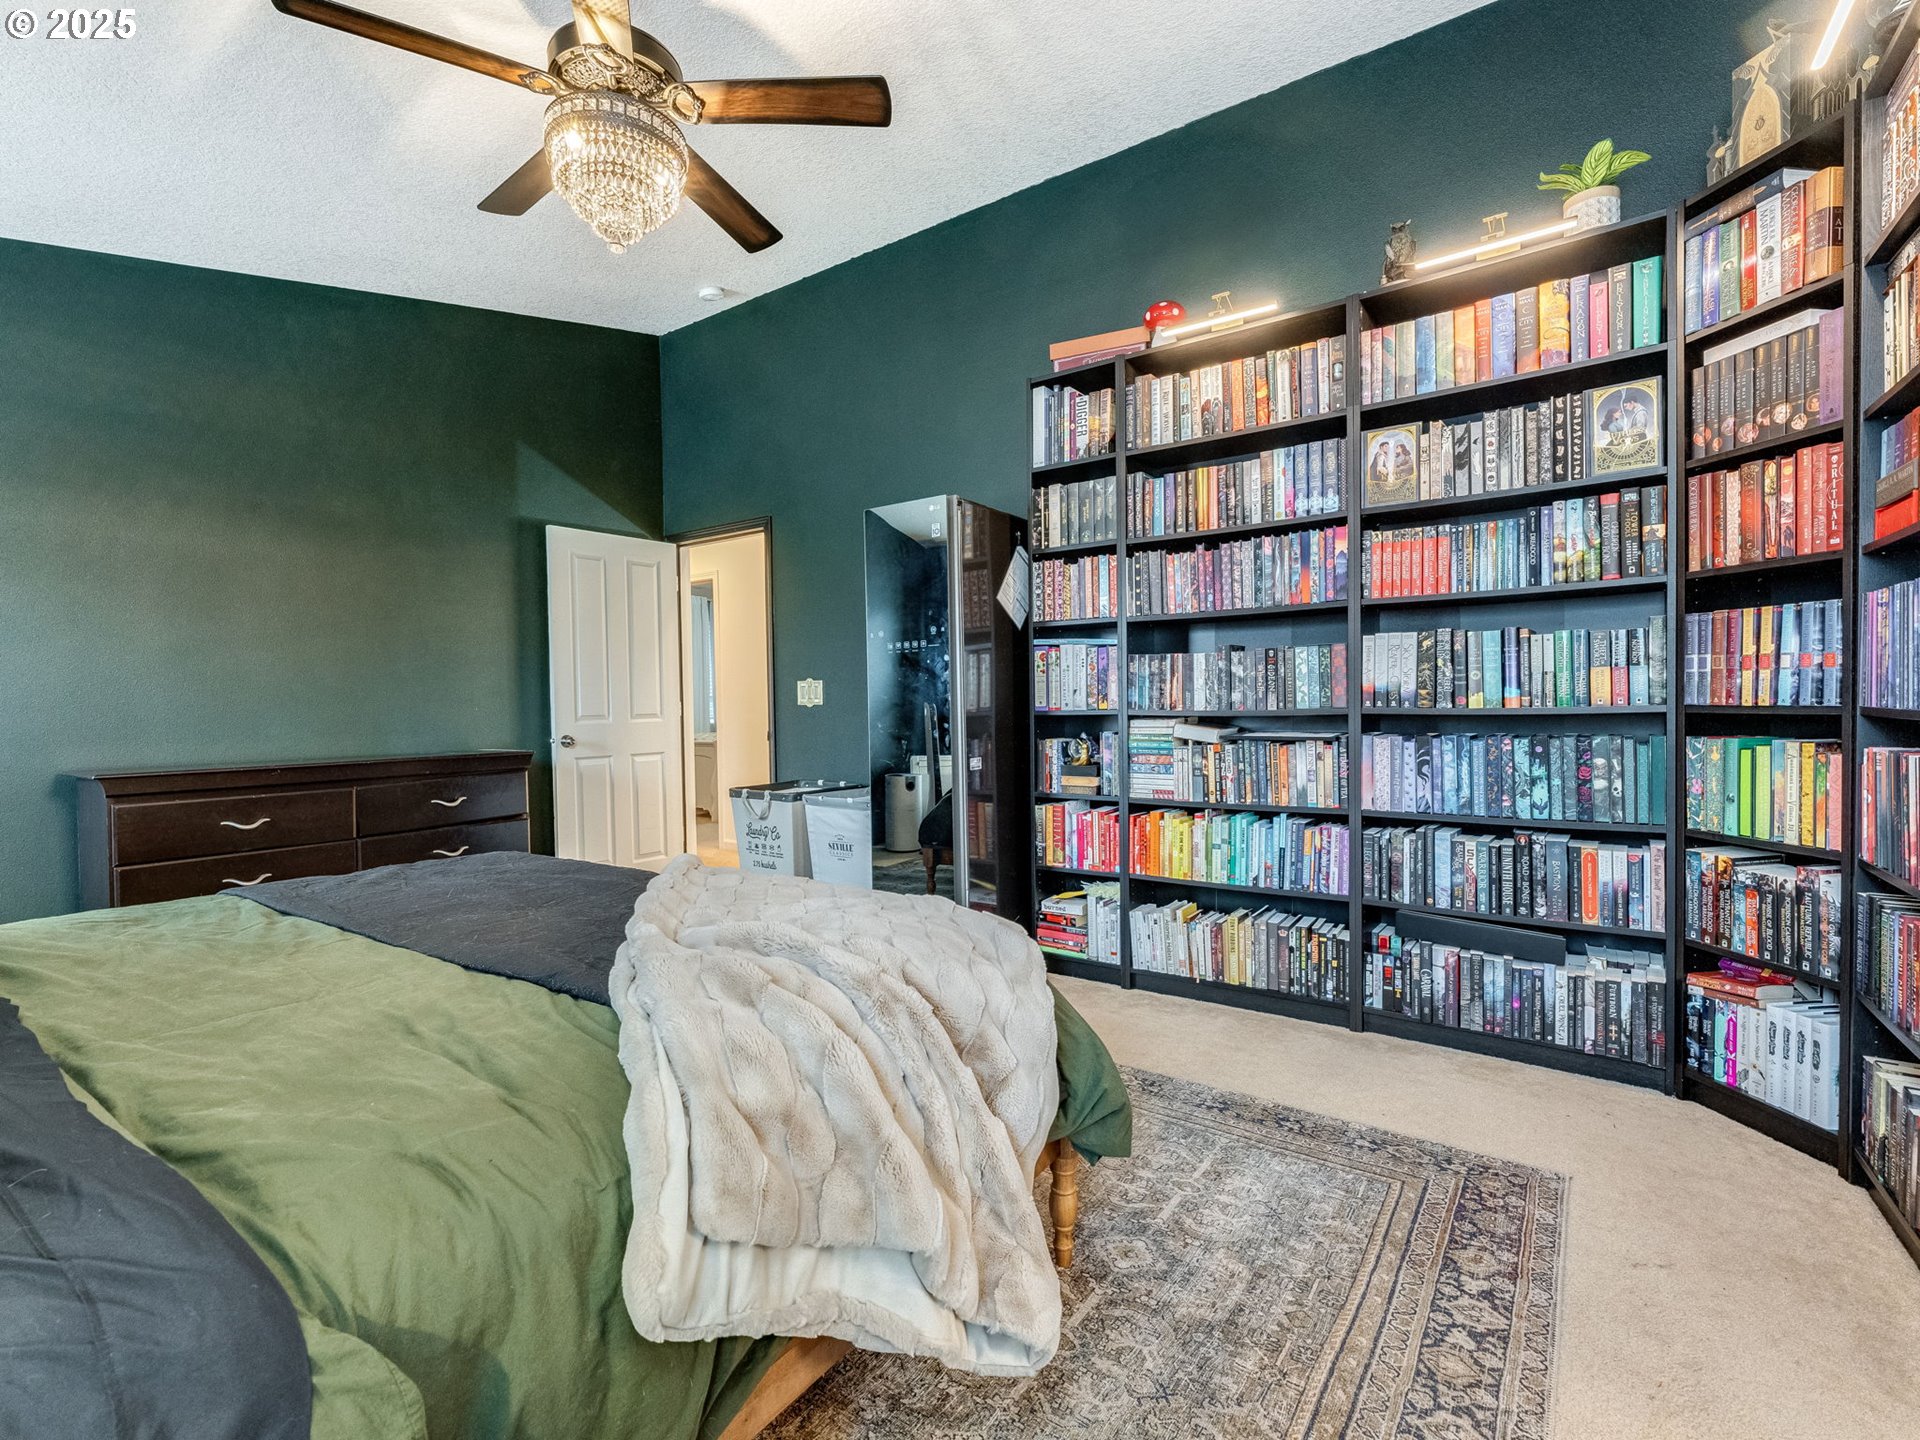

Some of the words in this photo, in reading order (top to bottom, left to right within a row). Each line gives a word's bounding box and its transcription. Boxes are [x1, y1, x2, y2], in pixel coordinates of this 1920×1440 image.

[1781, 192, 1790, 237] MARTIN
[1789, 185, 1799, 220] GEORGE
[1760, 208, 1769, 246] MARTIN
[1789, 248, 1798, 268] FIRE
[1076, 400, 1088, 437] DIGGER
[1602, 514, 1610, 537] BLOOD
[1610, 521, 1619, 551] CHILDREN
[1602, 546, 1611, 565] BONE
[1389, 644, 1400, 669] REAPER
[1403, 644, 1412, 661] SKY
[1268, 664, 1276, 691] GIDEON
[1787, 753, 1796, 785] Assistant
[746, 822, 769, 841] Laundry
[770, 825, 781, 841] Co
[828, 842, 855, 852] SEVILLE
[1478, 851, 1487, 889] WARRIOR
[1503, 858, 1512, 880] NINTH
[1552, 860, 1561, 892] BASTION
[1503, 881, 1512, 905] HOUSE
[1522, 881, 1530, 904] BONES
[1804, 895, 1812, 924] AUTUMN
[1804, 926, 1812, 959] REPUBLIC
[1828, 924, 1836, 956] GWYNNE
[1421, 968, 1432, 998] CARAVAL
[1608, 983, 1617, 1019] FURYBORN
[1890, 1122, 1898, 1146] City
